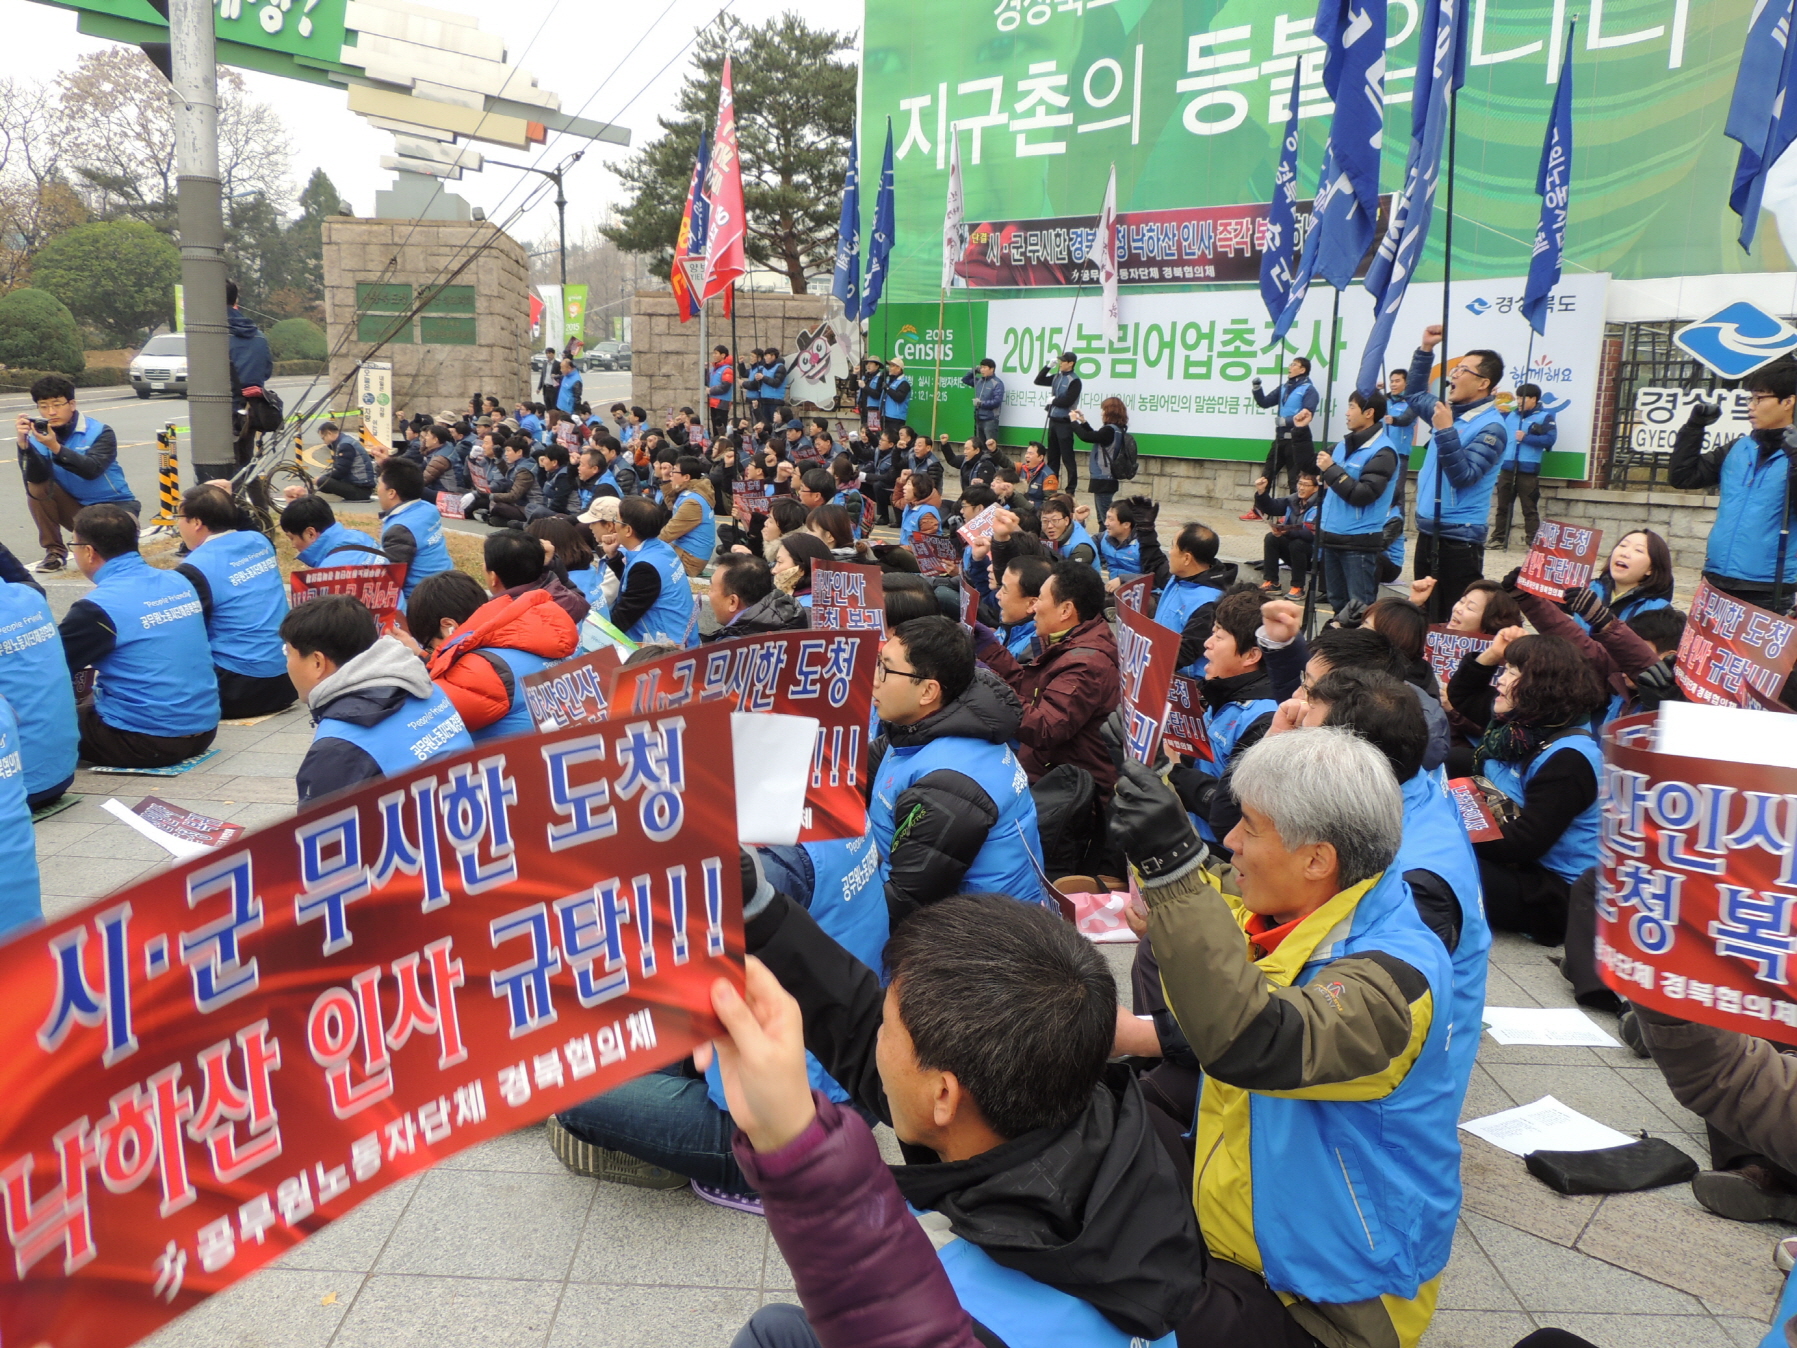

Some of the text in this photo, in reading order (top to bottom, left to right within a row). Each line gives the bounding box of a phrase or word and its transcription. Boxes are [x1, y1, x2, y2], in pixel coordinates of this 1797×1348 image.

[895, 44, 1144, 169] 지구촌의
[971, 232, 987, 243] 단결
[1027, 229, 1069, 264] 무시한
[1130, 222, 1177, 261] 낙하산
[1180, 219, 1214, 259] 인사
[1216, 217, 1252, 258] 즉각
[1162, 264, 1215, 279] 경북협의체
[894, 338, 953, 361] Census
[925, 329, 953, 341] 2015
[1002, 326, 1063, 375] 2015
[1740, 611, 1796, 660] 도청
[788, 636, 861, 709] 도청
[37, 715, 687, 1068] 시·군 무시한 도청
[0, 857, 726, 1280] 낙하산 인사 규탄!!!
[195, 1008, 659, 1275] 공무원노동자단체 경북협의체
